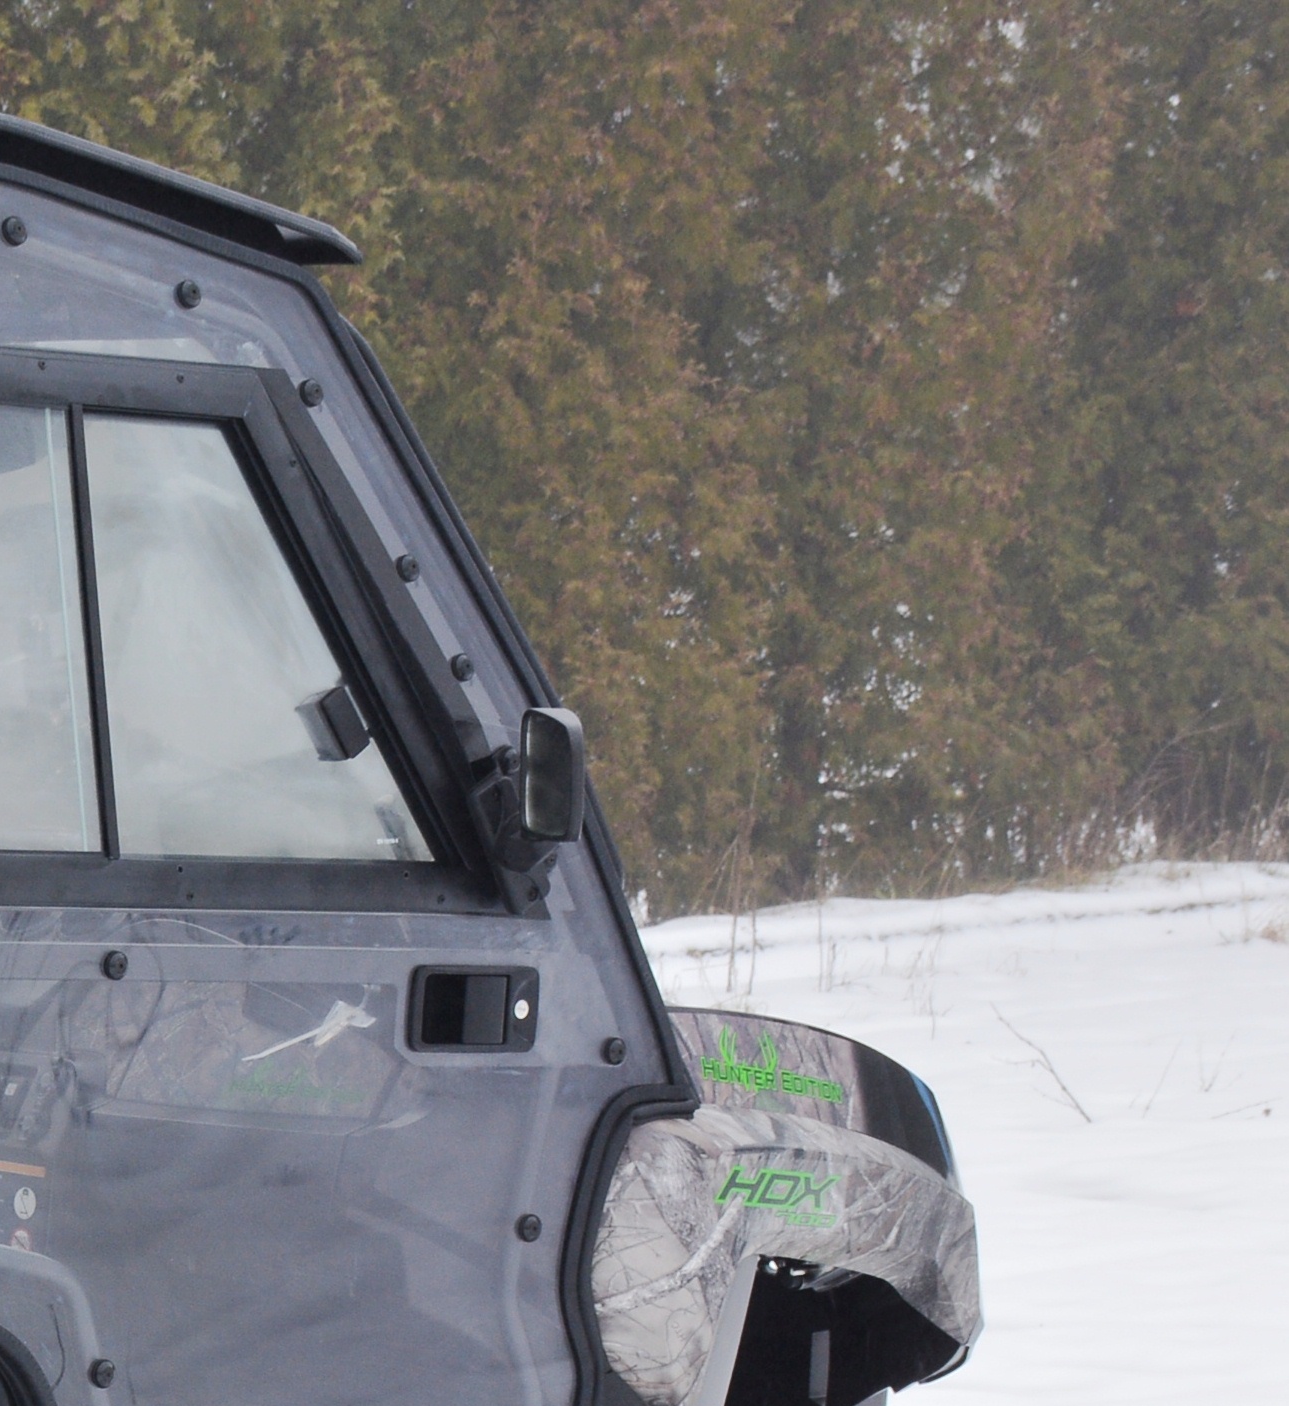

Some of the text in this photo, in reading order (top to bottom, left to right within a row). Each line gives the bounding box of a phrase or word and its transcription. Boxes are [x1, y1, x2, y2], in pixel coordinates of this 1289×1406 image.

[700, 1056, 843, 1104] HUNTER EDITION
[715, 1165, 842, 1212] HDX
[775, 1210, 837, 1228] 700
